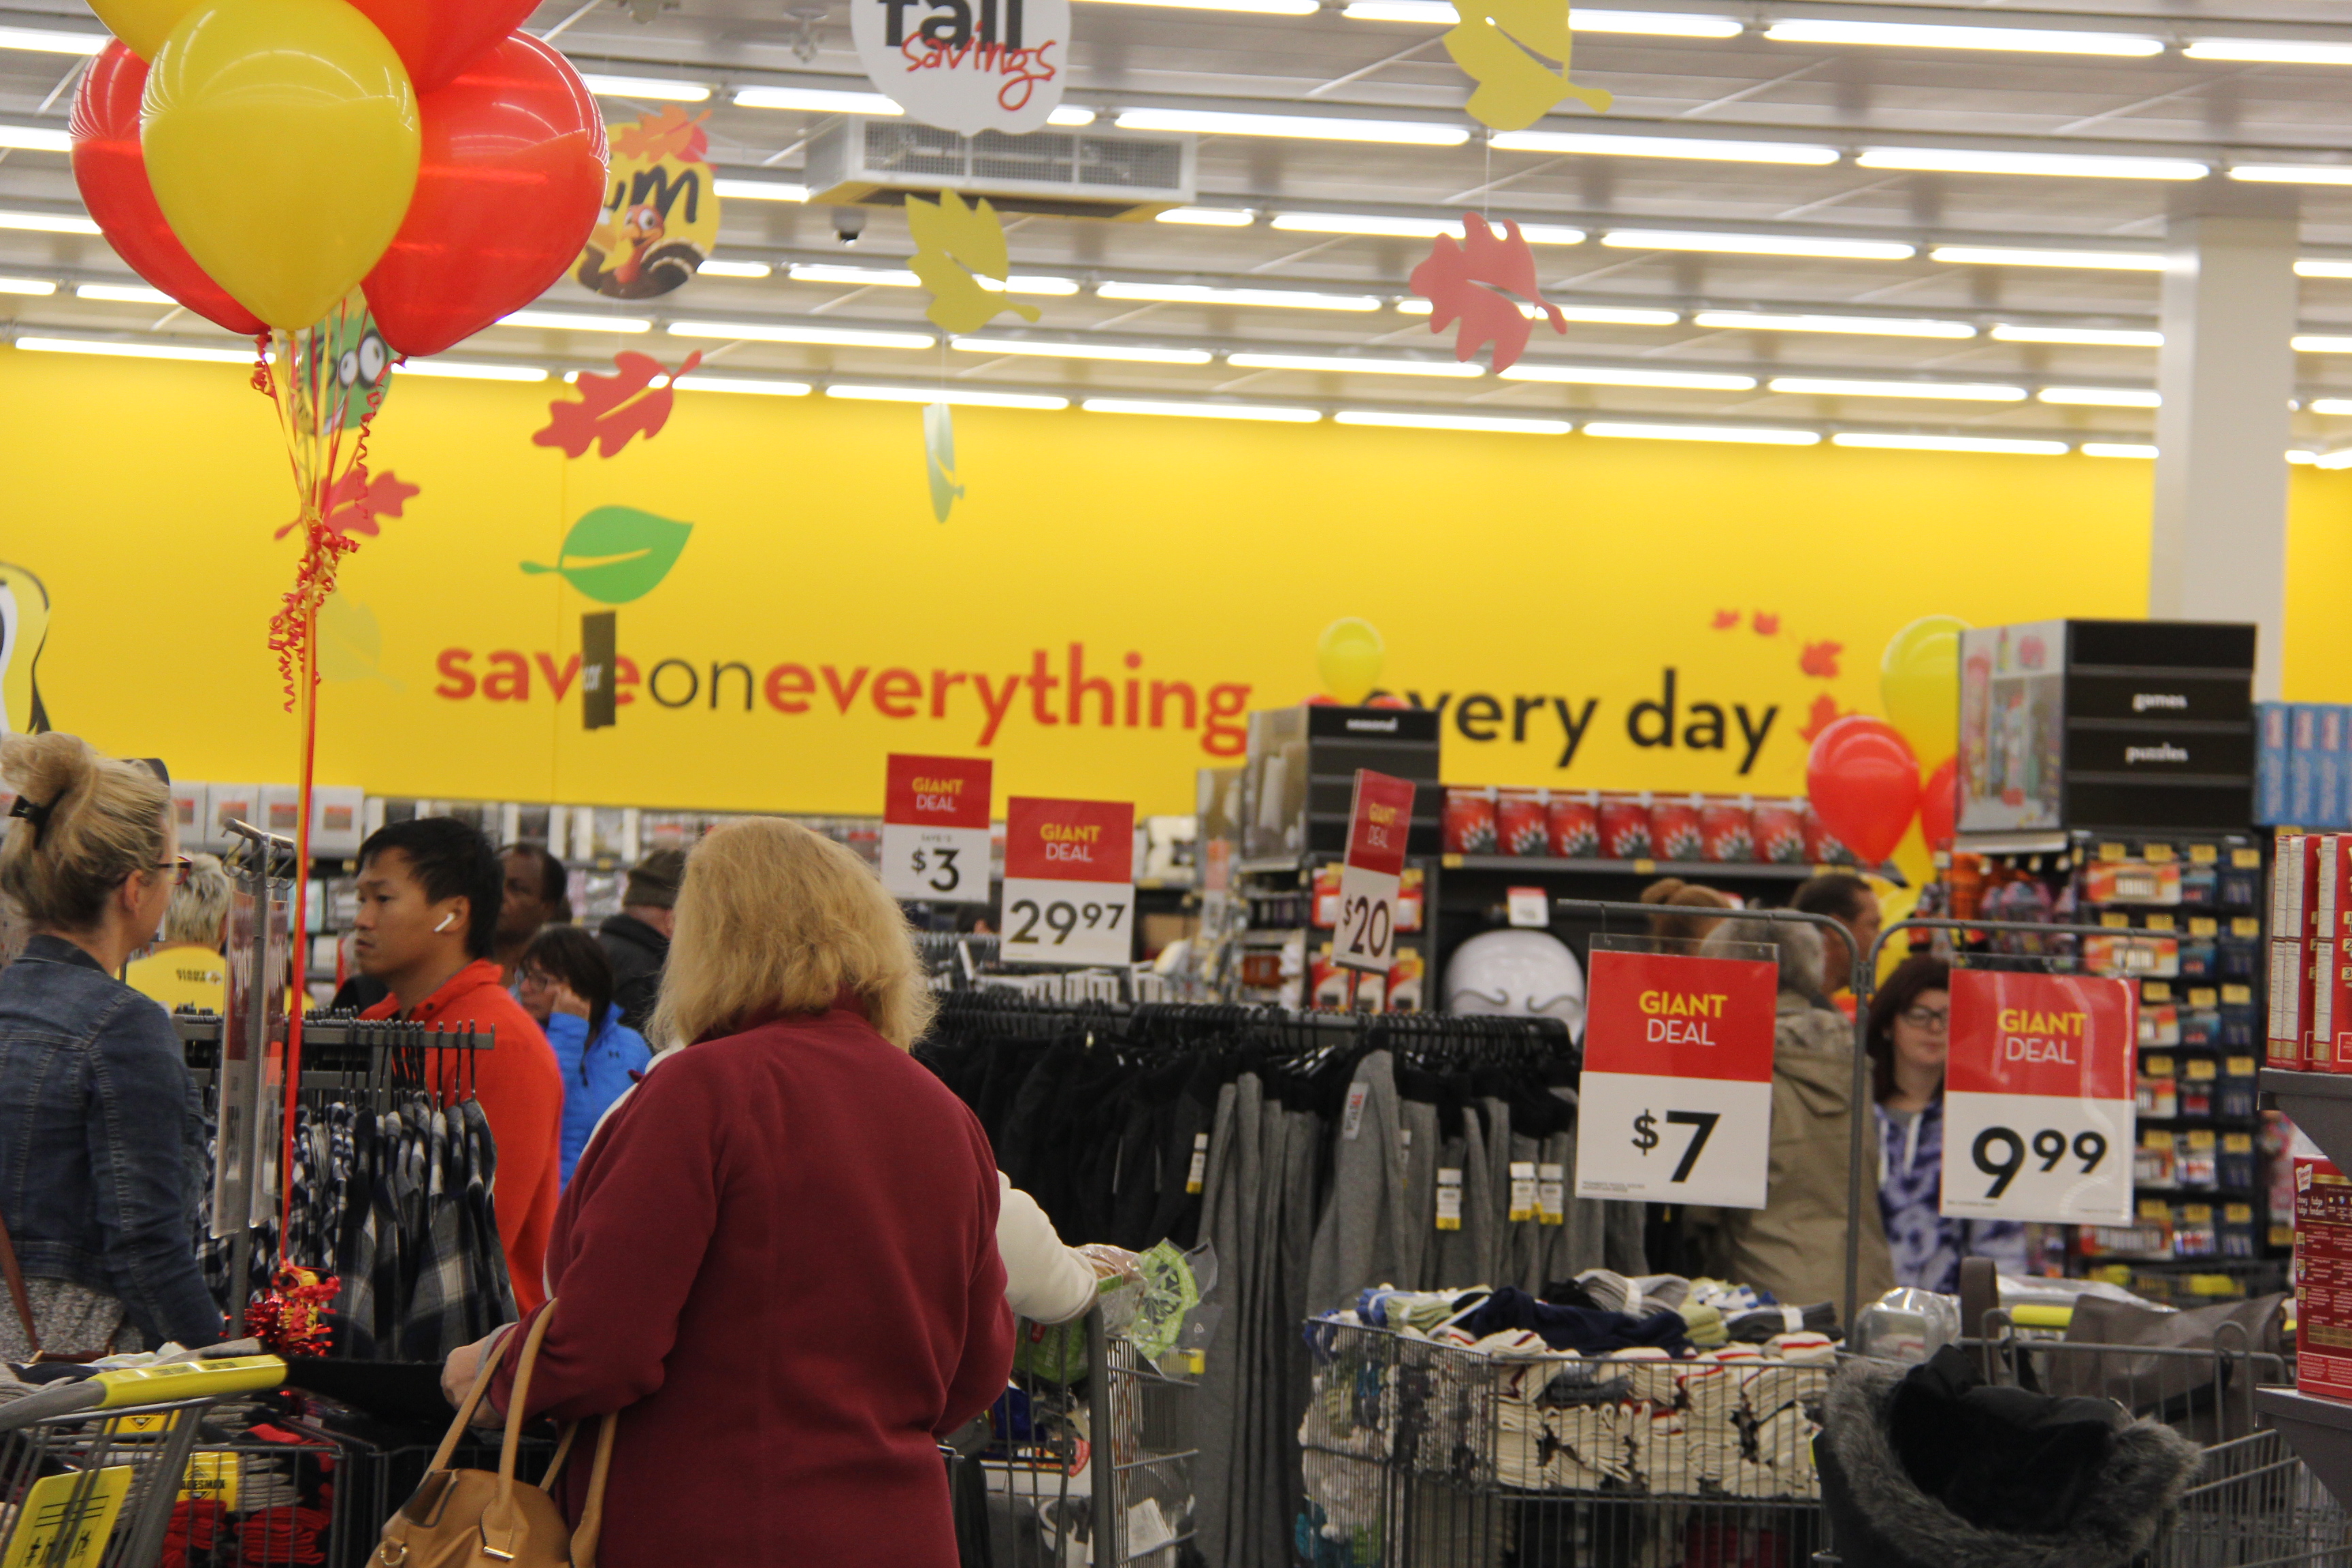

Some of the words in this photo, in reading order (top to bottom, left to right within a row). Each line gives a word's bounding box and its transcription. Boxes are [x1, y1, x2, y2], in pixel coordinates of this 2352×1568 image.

[902, 20, 1057, 111] savings
[2132, 693, 2187, 712] games
[1627, 666, 1780, 775] day
[2125, 742, 2189, 764] puzzles
[911, 777, 964, 795] GIANT
[916, 794, 956, 812] DEAL
[1369, 802, 1397, 826] GIANT
[1040, 823, 1102, 843] GIANT
[1367, 825, 1389, 848] DEAL
[1045, 843, 1094, 862] DEAL
[911, 847, 960, 892] $3
[1343, 893, 1390, 958] $20
[1639, 990, 1728, 1018] GIANT
[1647, 1018, 1716, 1046] DEAL
[1997, 1009, 2087, 1036] GIANT
[2005, 1037, 2076, 1064] DEAL
[1631, 1108, 1721, 1183] $7
